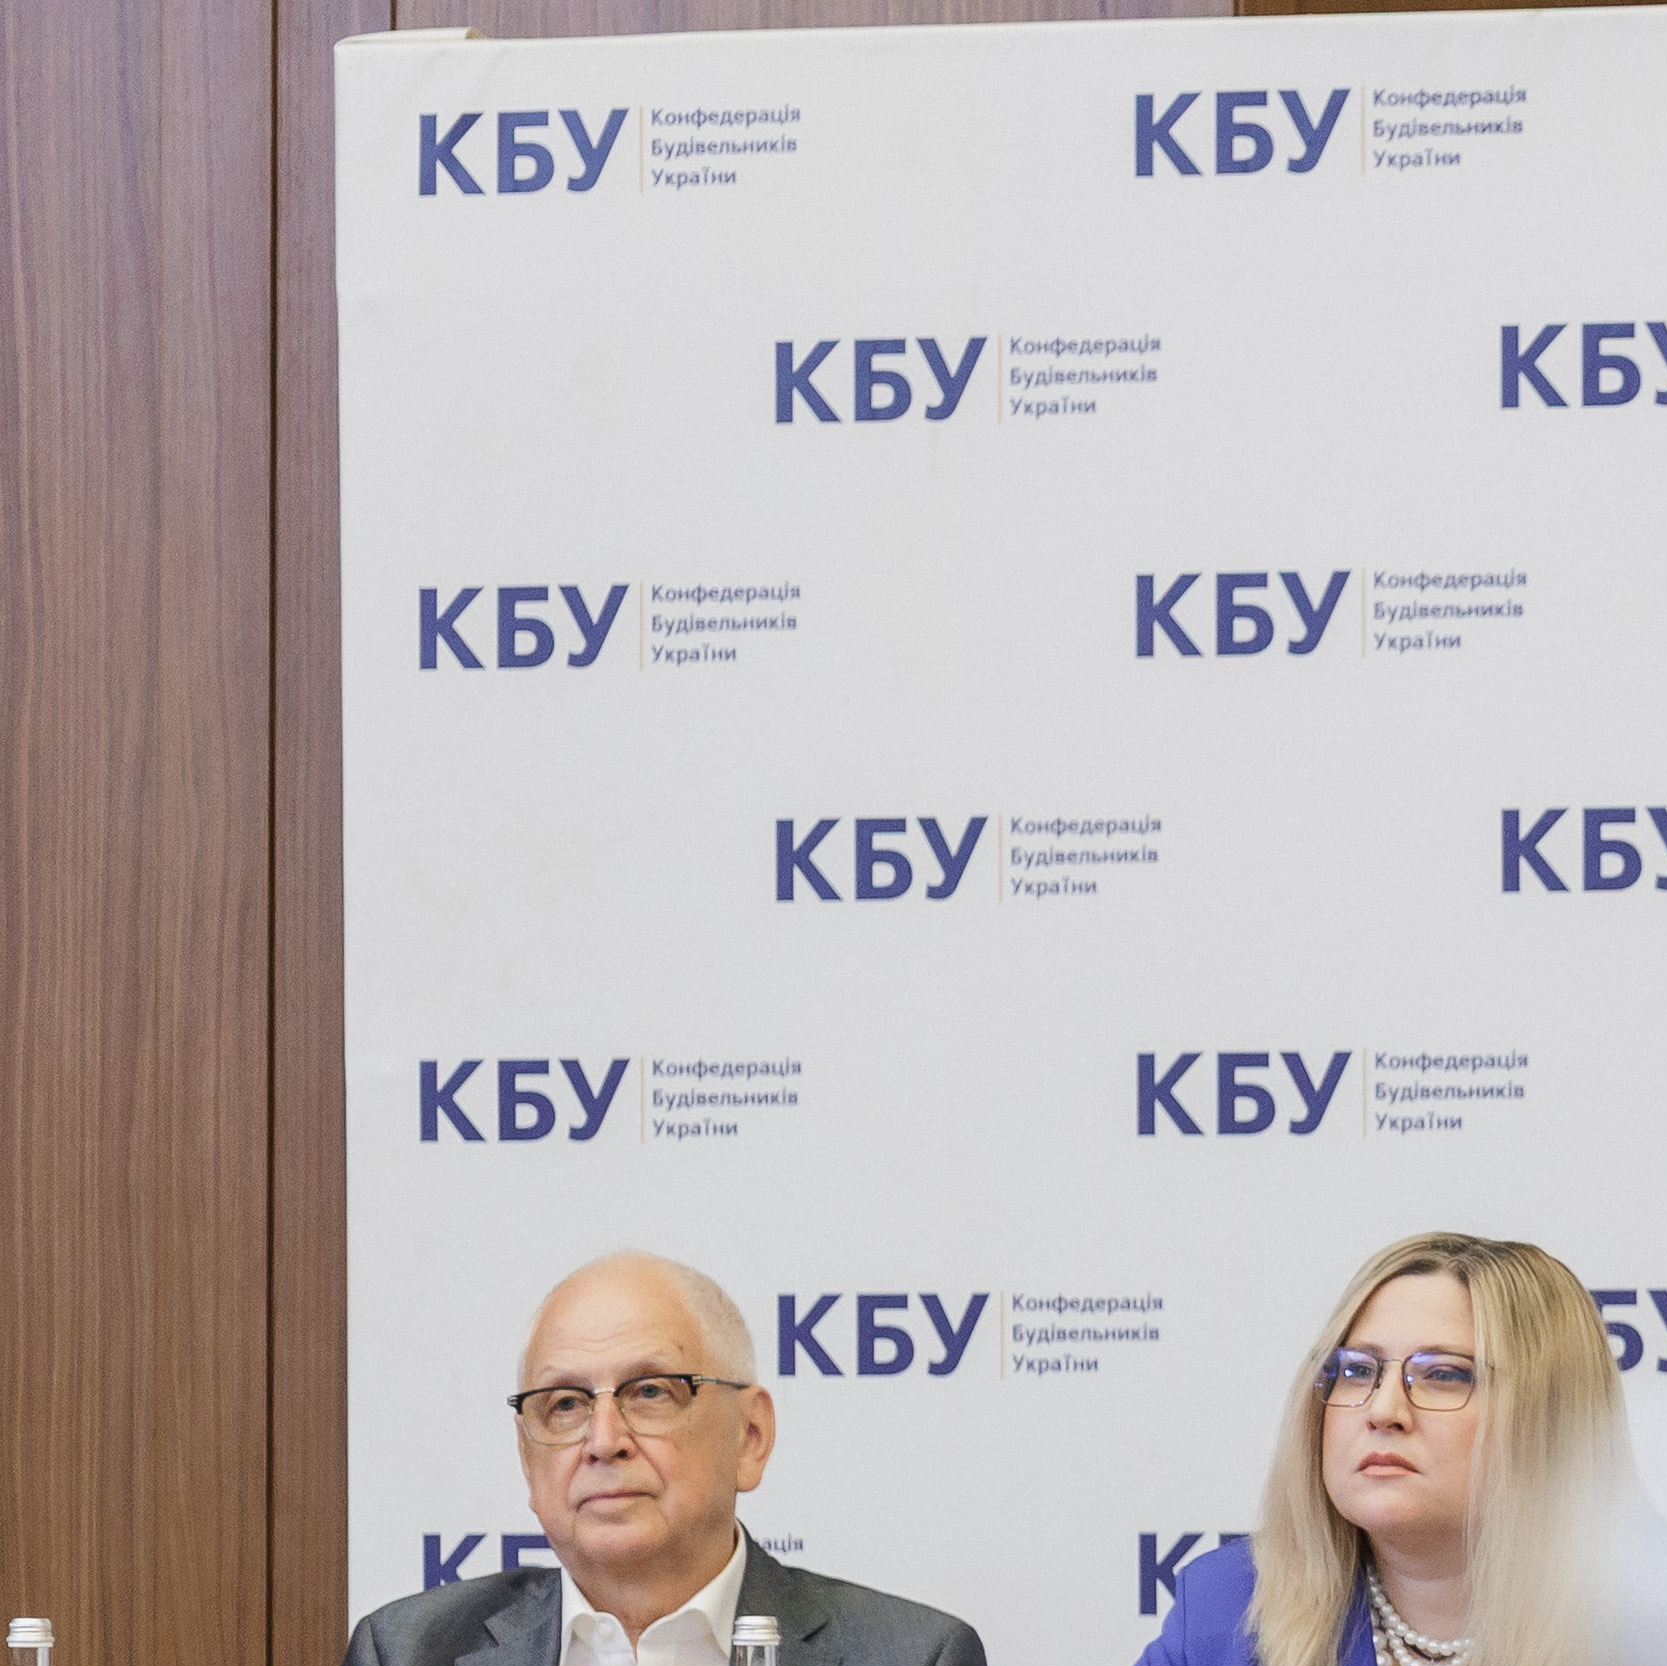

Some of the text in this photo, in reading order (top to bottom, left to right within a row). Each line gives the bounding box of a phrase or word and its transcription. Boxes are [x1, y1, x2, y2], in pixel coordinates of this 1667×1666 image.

[651, 104, 801, 130] Конфедерація
[1135, 88, 1351, 178] КБУ
[419, 108, 629, 197] КБУ
[651, 135, 797, 161] Будівельників
[651, 166, 737, 191] України
[775, 336, 987, 425] КБУ
[1373, 568, 1528, 593] Конфедерація
[1136, 570, 1351, 658] КБУ
[1373, 599, 1524, 624] Будівельників
[419, 584, 629, 671] КБУ
[1374, 630, 1462, 655] України
[776, 816, 988, 902] КБУ
[1374, 1049, 1529, 1074] Конфедерація
[419, 1058, 630, 1143] КБУ
[1137, 1051, 1352, 1137] КБУ
[1374, 1080, 1526, 1105] Будівельників
[1375, 1111, 1463, 1135] України
[1012, 1293, 1164, 1316] Конфедерація
[777, 1293, 990, 1377] КБУ
[1012, 1323, 1160, 1347] Будівельників
[1012, 1353, 1099, 1377] України
